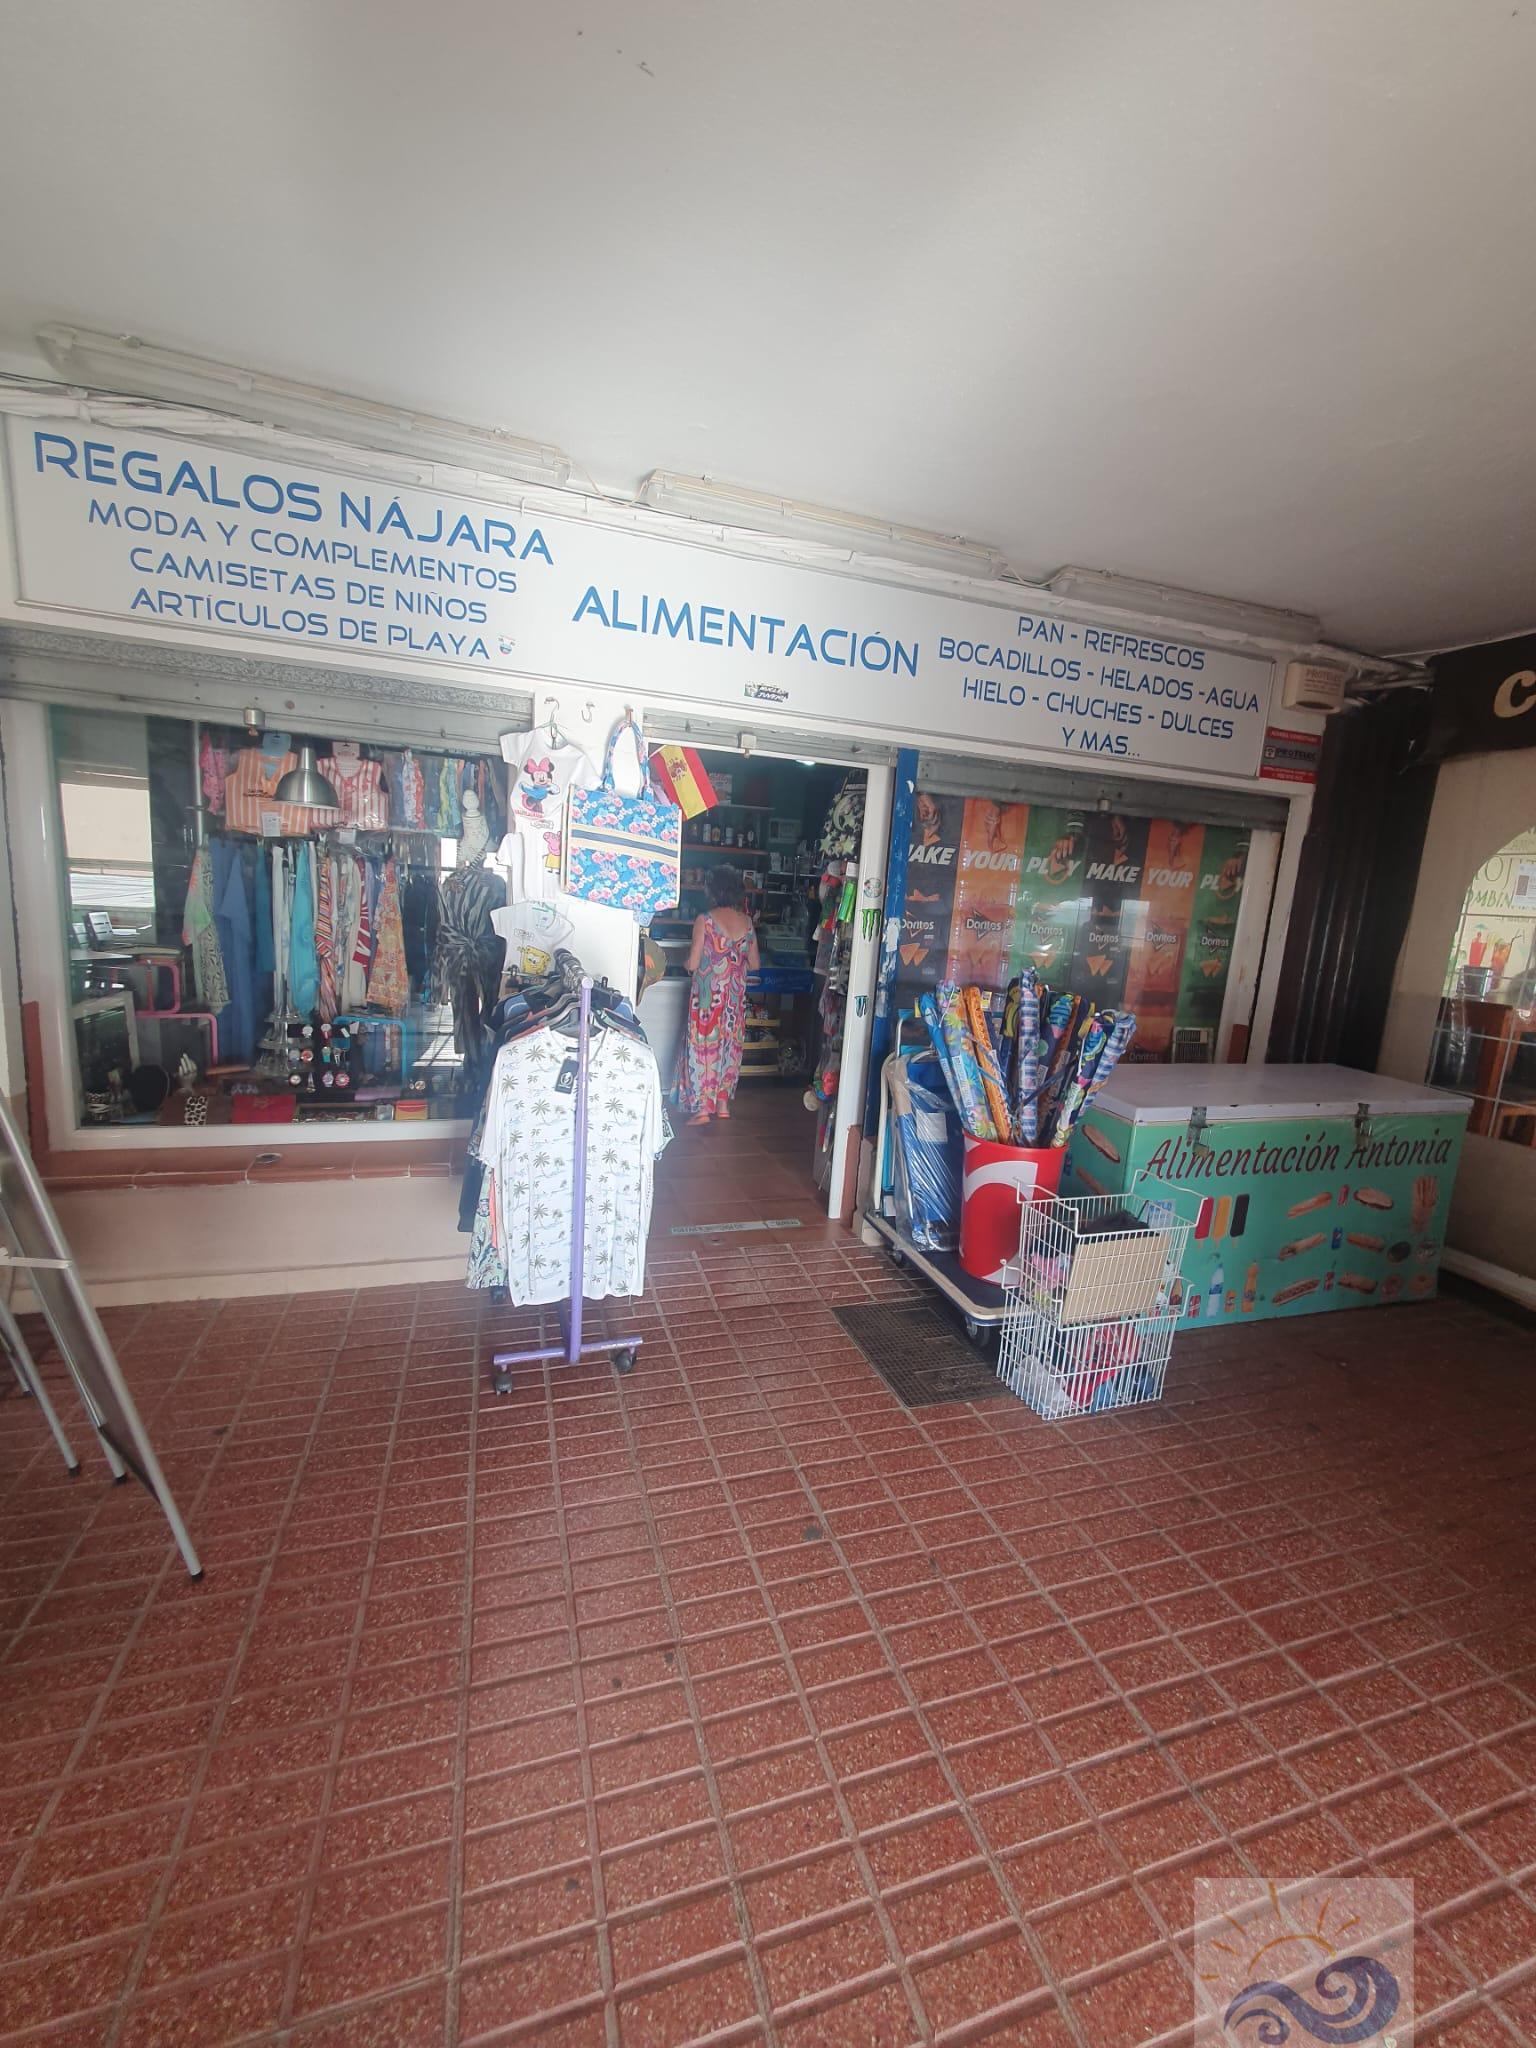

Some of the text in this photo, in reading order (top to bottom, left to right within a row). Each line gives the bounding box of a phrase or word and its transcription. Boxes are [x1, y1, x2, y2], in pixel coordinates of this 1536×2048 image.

[33, 431, 555, 566] REGALOS NÁJARA
[88, 499, 518, 594] MODA Y COMPLEMENTOS
[129, 546, 488, 624] CAMISETAS DE NIÑOS
[129, 587, 491, 660] ARTÍCULOS DE PLAYA
[571, 585, 920, 678] ALIMENTACIÓN
[1017, 616, 1065, 645] PAN
[1083, 629, 1205, 671] REFRESCOS
[938, 637, 1082, 682] BOCADILLOS
[1100, 666, 1194, 701] HELADOS
[963, 677, 1026, 707] HIELO
[1046, 691, 1143, 725] CHUCHES
[1160, 710, 1234, 740] DULCES
[1061, 726, 1076, 747] Y
[908, 844, 957, 866] AKE
[964, 850, 1019, 872] YOUR
[1086, 862, 1141, 883] MAKE
[1147, 868, 1194, 888] YOUR
[966, 918, 1002, 931] Doritos
[1031, 923, 1063, 936] Doritos
[1089, 932, 1120, 943] Doritos
[1146, 932, 1177, 943] Doritos
[1201, 936, 1229, 947] Doritos
[1139, 1131, 1339, 1182] Alimentación
